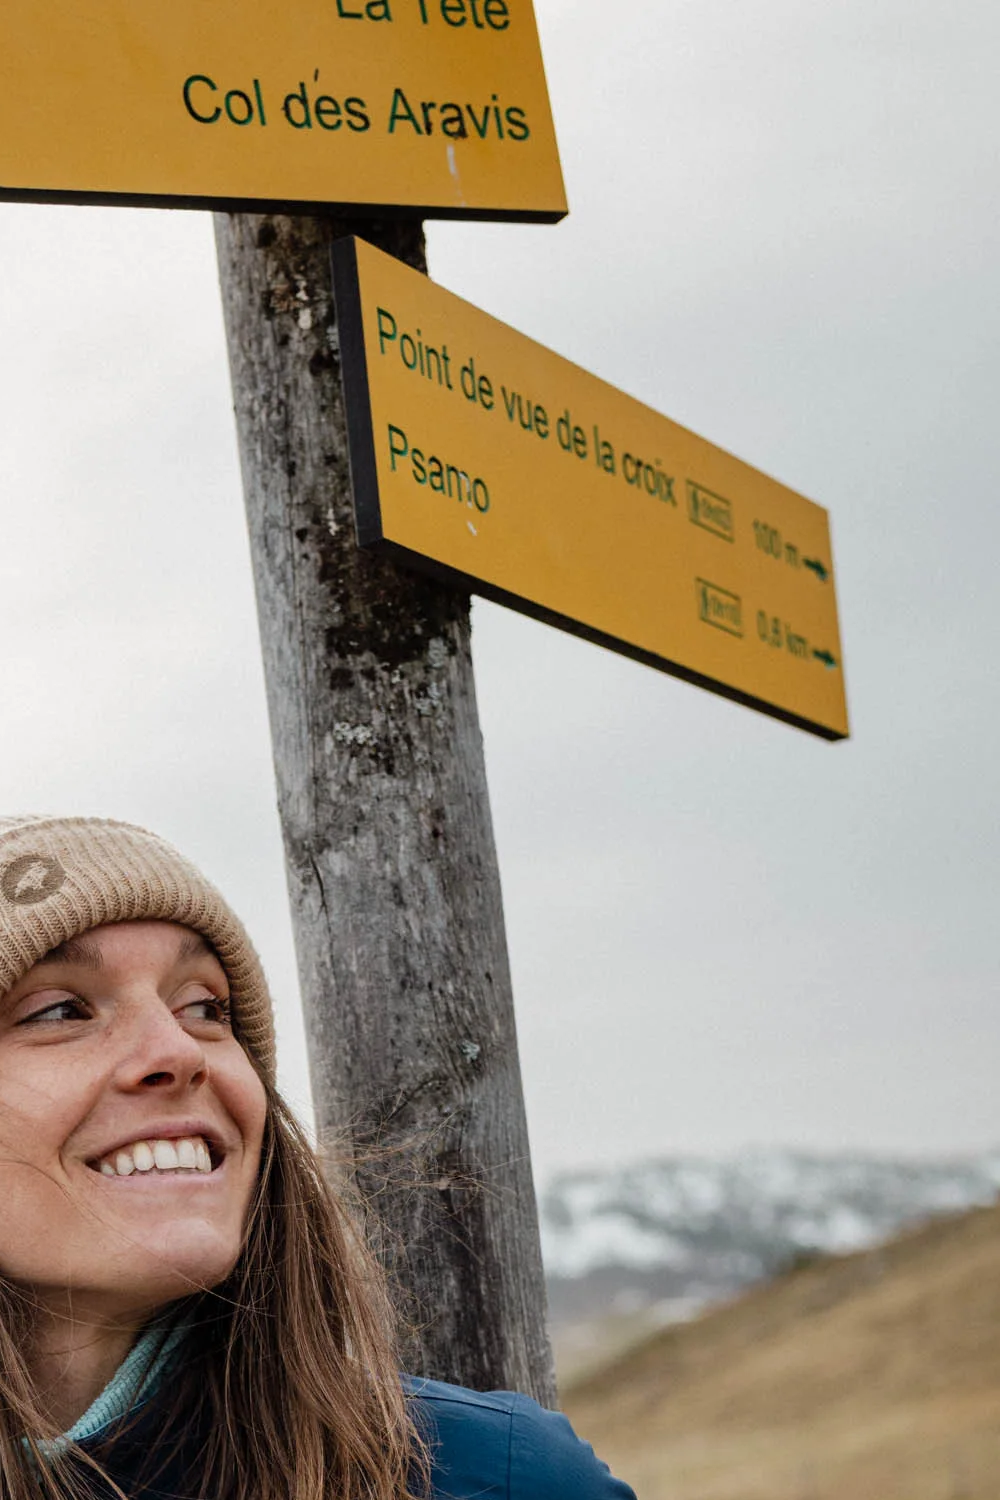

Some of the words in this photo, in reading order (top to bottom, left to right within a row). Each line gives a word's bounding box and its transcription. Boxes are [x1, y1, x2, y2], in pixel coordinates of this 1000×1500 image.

[182, 74, 267, 127] Col
[283, 81, 371, 133] des
[387, 87, 531, 141] Aravis
[376, 306, 453, 391] Point
[460, 356, 495, 411] de
[501, 385, 550, 440] vue
[556, 409, 588, 460] de
[592, 424, 617, 477] la
[622, 451, 678, 508] croix
[387, 423, 490, 514] Psamo
